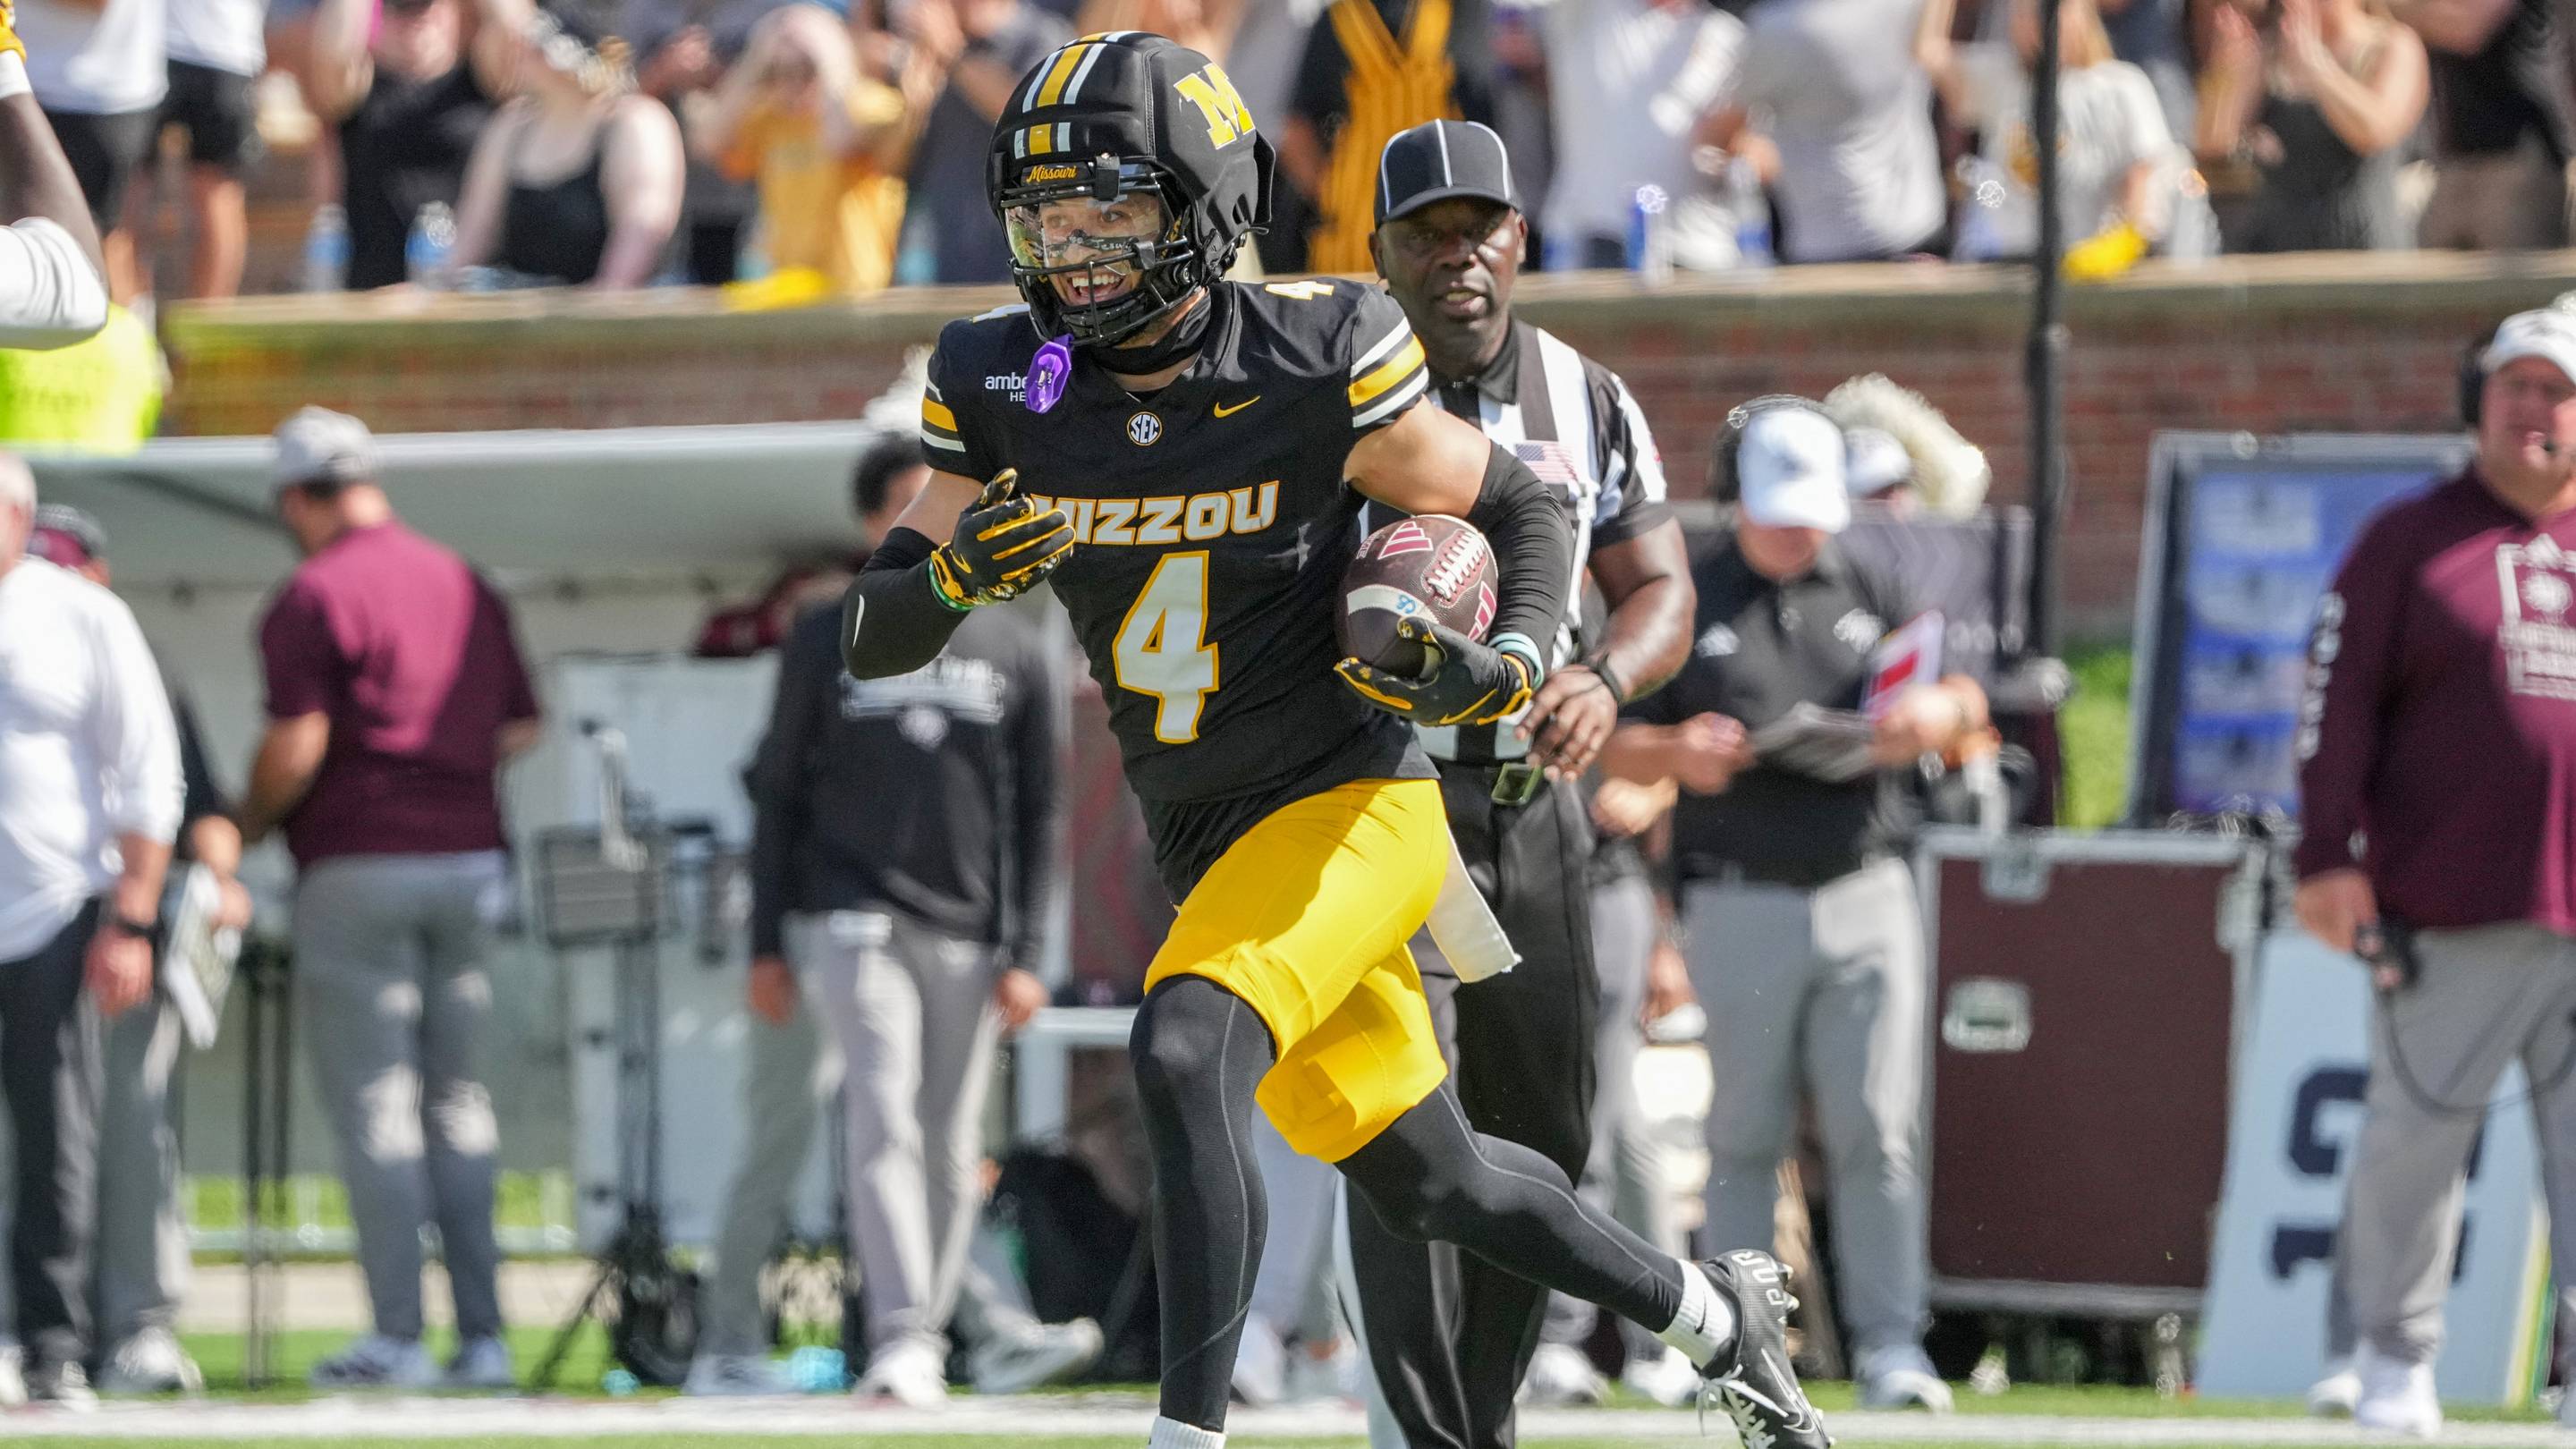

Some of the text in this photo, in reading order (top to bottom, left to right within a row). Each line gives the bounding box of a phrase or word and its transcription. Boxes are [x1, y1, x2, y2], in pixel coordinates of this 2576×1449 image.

[1174, 63, 1256, 149] M
[1026, 165, 1077, 183] Missouri
[1266, 281, 1335, 301] 4
[1130, 414, 1159, 444] SEC
[1112, 550, 1220, 744] 4
